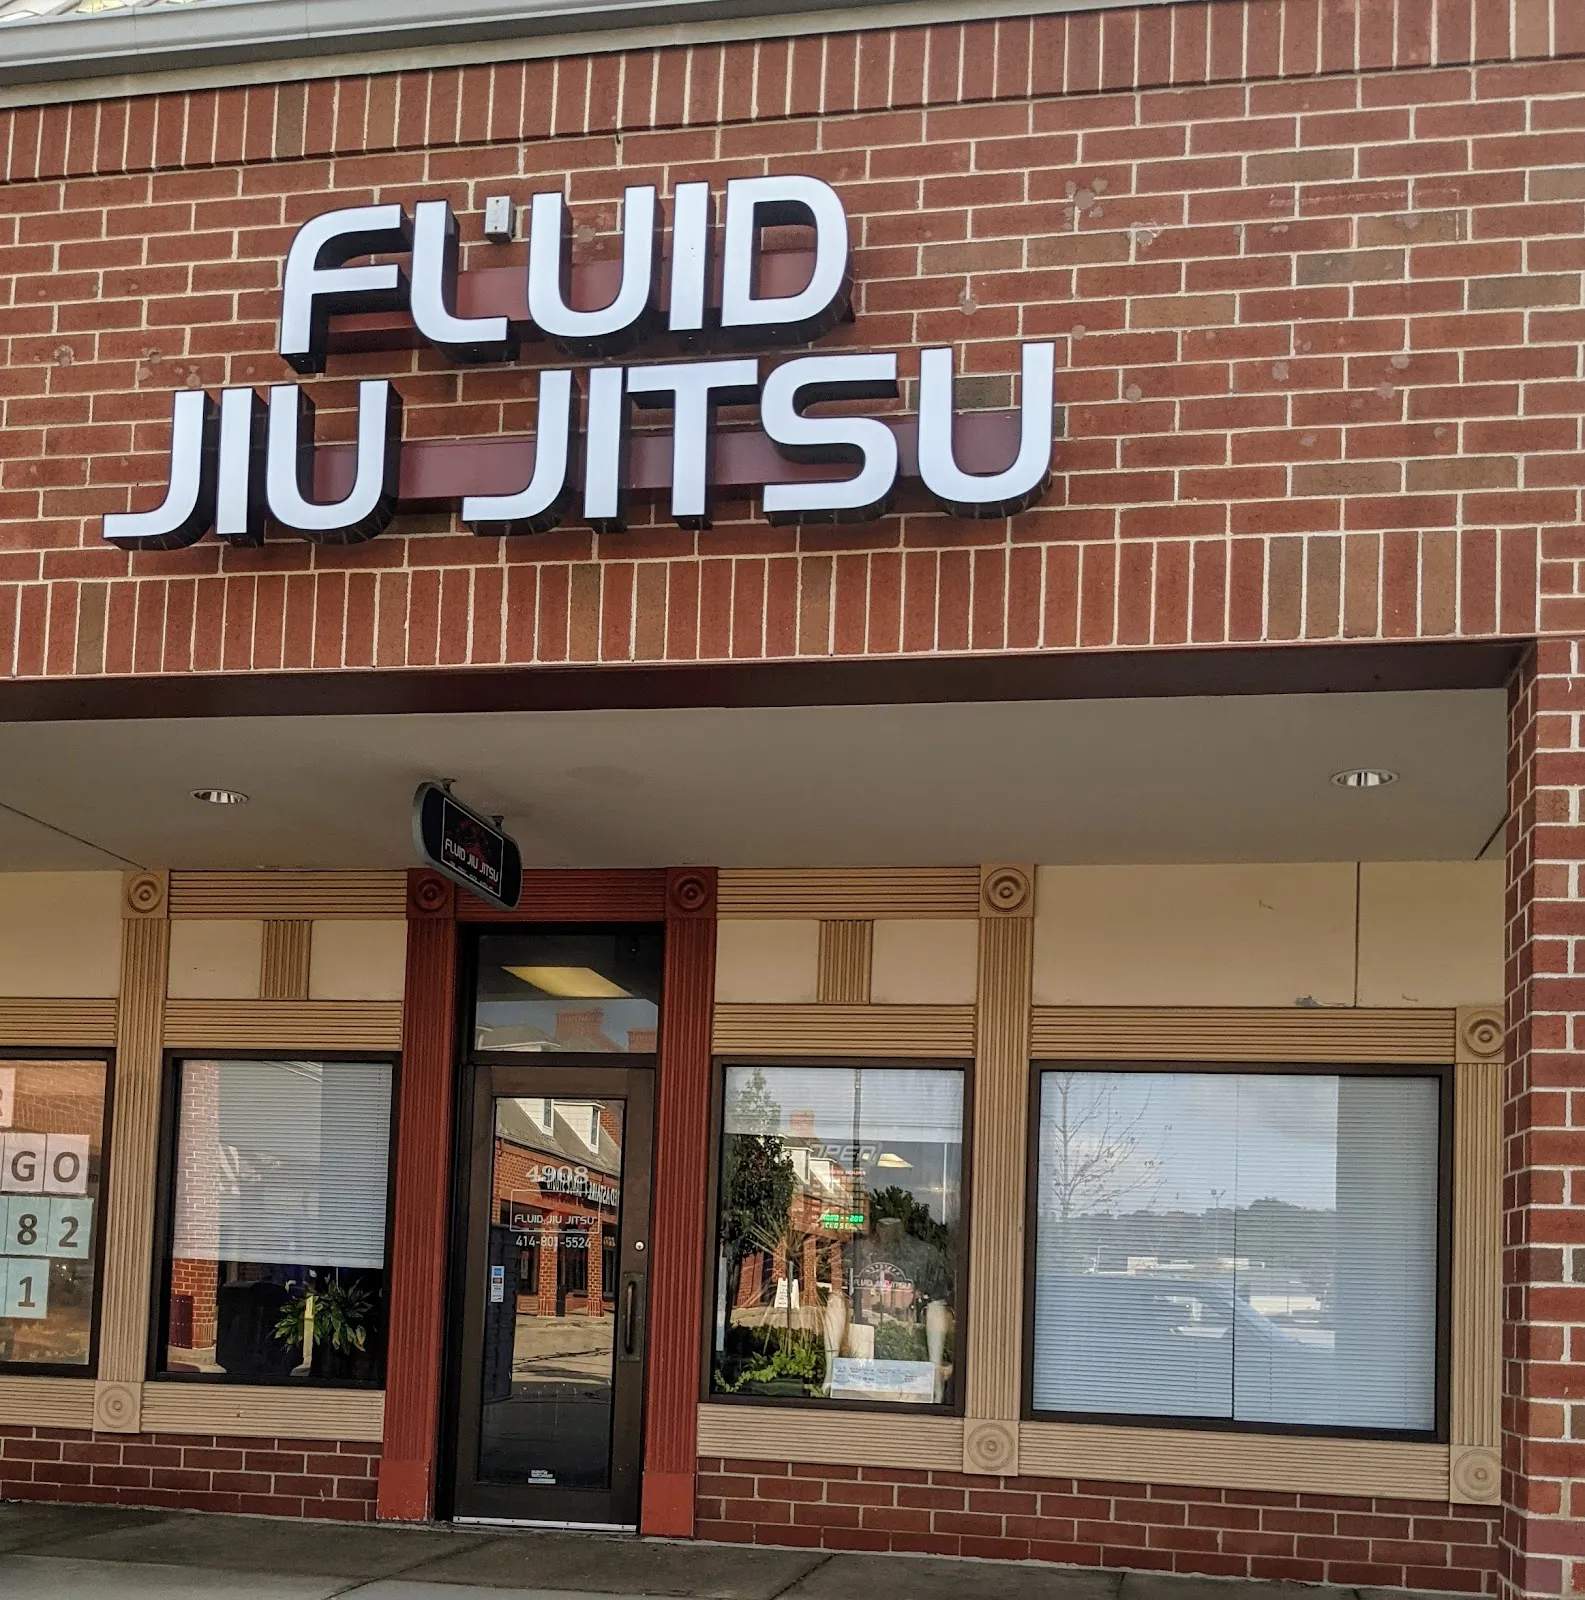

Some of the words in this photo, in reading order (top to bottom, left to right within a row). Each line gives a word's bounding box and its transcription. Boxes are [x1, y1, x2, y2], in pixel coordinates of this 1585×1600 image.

[279, 174, 850, 357] FLUID
[102, 379, 391, 539] JIU
[461, 341, 1056, 522] JITSU
[445, 838, 466, 862] FLUID
[467, 853, 479, 870] JIU
[479, 861, 500, 883] JITSU
[10, 1150, 81, 1184] GO
[525, 1165, 589, 1183] 4908
[16, 1213, 80, 1249] 82
[514, 1214, 544, 1224] FLUID
[546, 1215, 563, 1225] JIU
[564, 1216, 596, 1226] JITSU
[17, 1275, 36, 1308] 1
